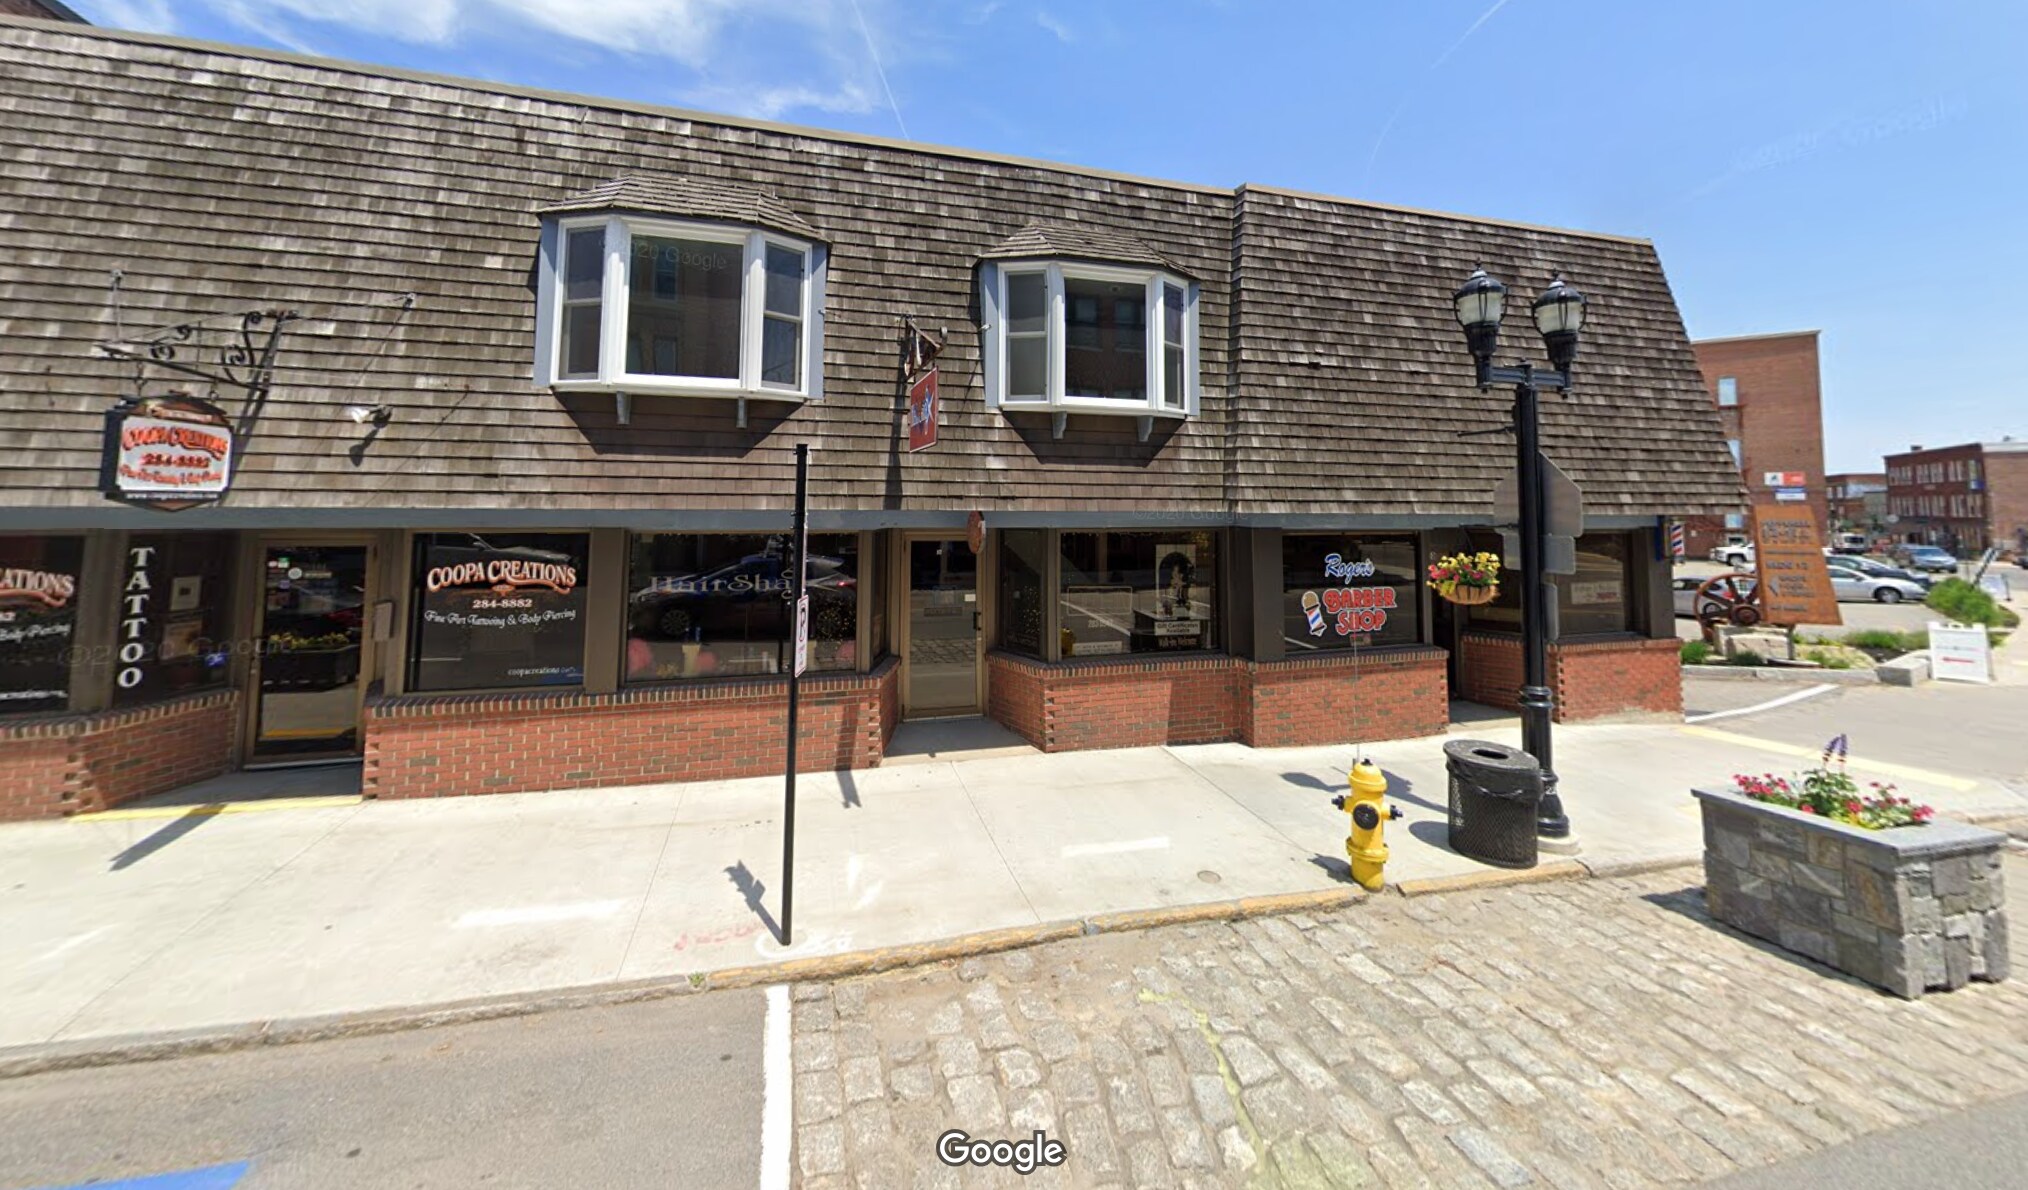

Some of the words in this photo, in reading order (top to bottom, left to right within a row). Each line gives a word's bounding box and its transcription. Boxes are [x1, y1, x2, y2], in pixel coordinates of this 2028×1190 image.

[0, 567, 75, 598] ATIONS
[427, 562, 485, 593] COOPA
[487, 560, 577, 595] CREATIONS
[472, 599, 533, 609] 284-8882
[1322, 587, 1398, 614] BARBER
[117, 547, 155, 688] TATTOO
[506, 615, 516, 625] &
[518, 613, 541, 626] Body
[542, 609, 577, 622] Piercing
[1335, 608, 1387, 635] SHOP
